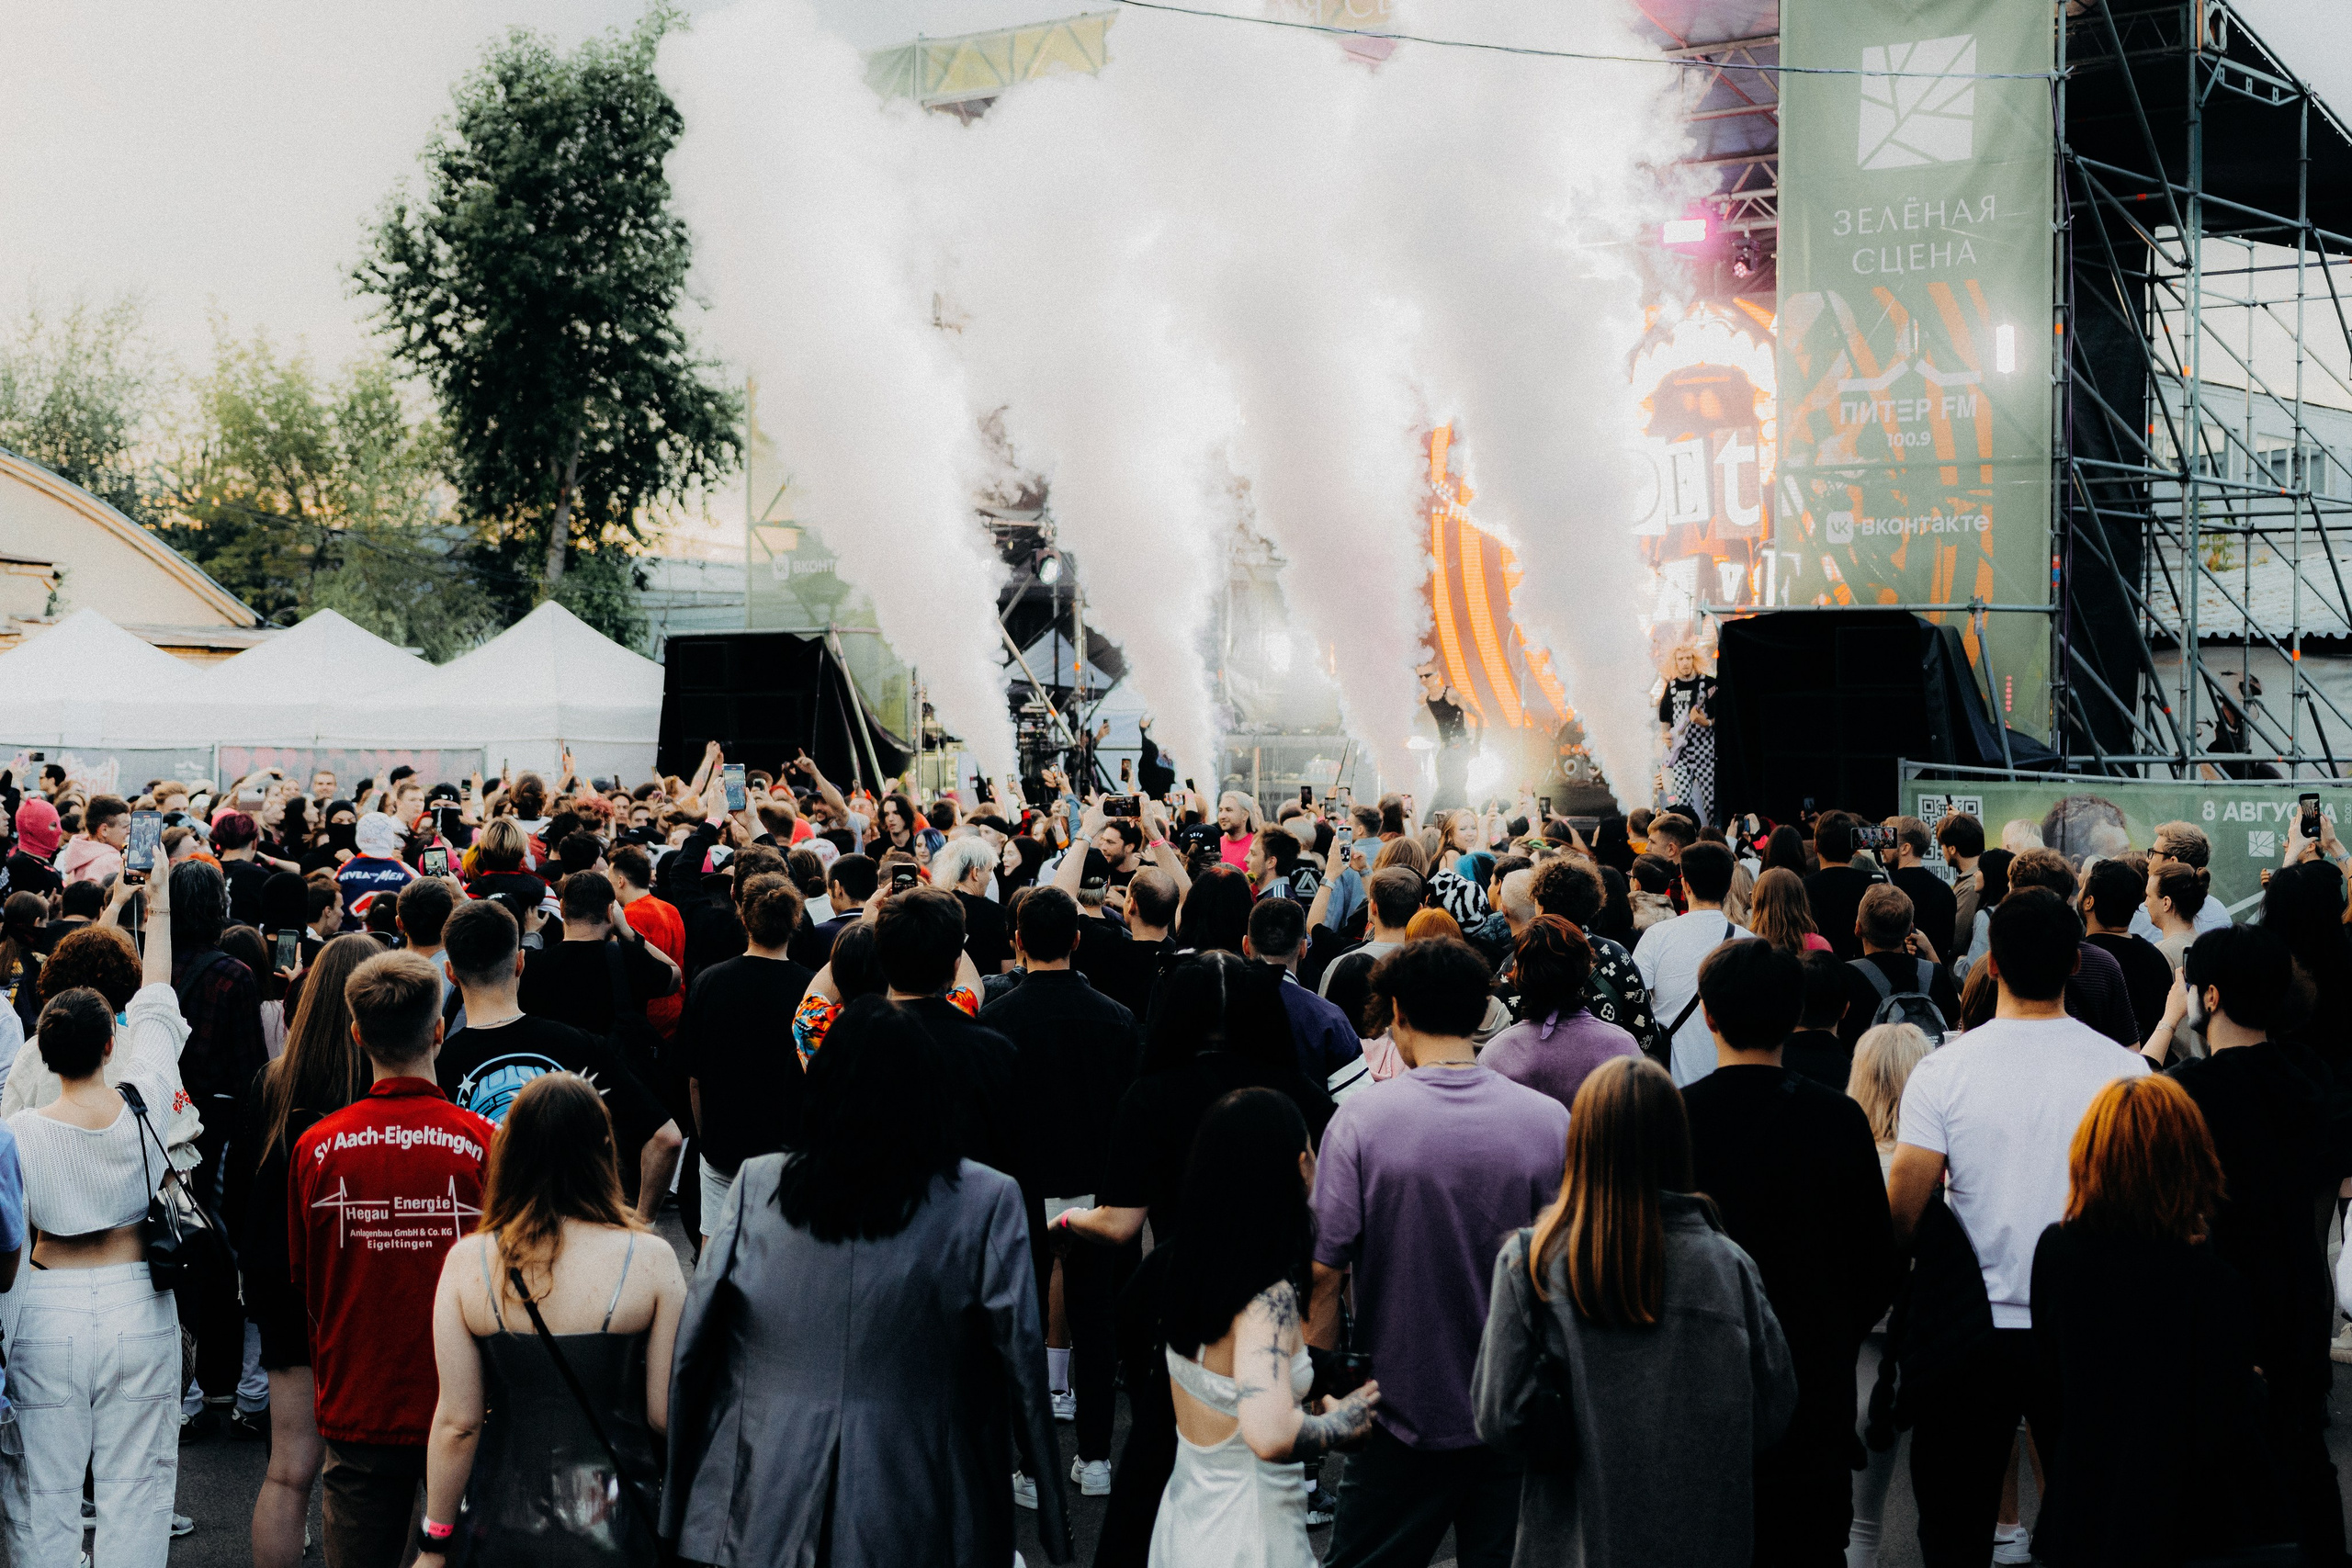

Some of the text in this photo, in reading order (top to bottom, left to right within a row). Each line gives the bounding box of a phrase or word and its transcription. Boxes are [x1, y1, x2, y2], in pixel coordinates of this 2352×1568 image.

[1834, 195, 1996, 235] ЗЕЛЁНАЯ
[1852, 240, 1976, 274] СЦЕНА
[1840, 394, 1977, 424] ПИТЕР FM
[1887, 432, 1931, 447] 100.9
[2202, 800, 2338, 824] 8 АВГУСА
[338, 871, 371, 882] NIVEA
[334, 1125, 483, 1161] Aach-Eigeltingen
[345, 1196, 451, 1222] Hegau Energie
[350, 1227, 453, 1239] Anlagenbau GmbH & Co. KG
[368, 1240, 433, 1251] Eigeltingen
